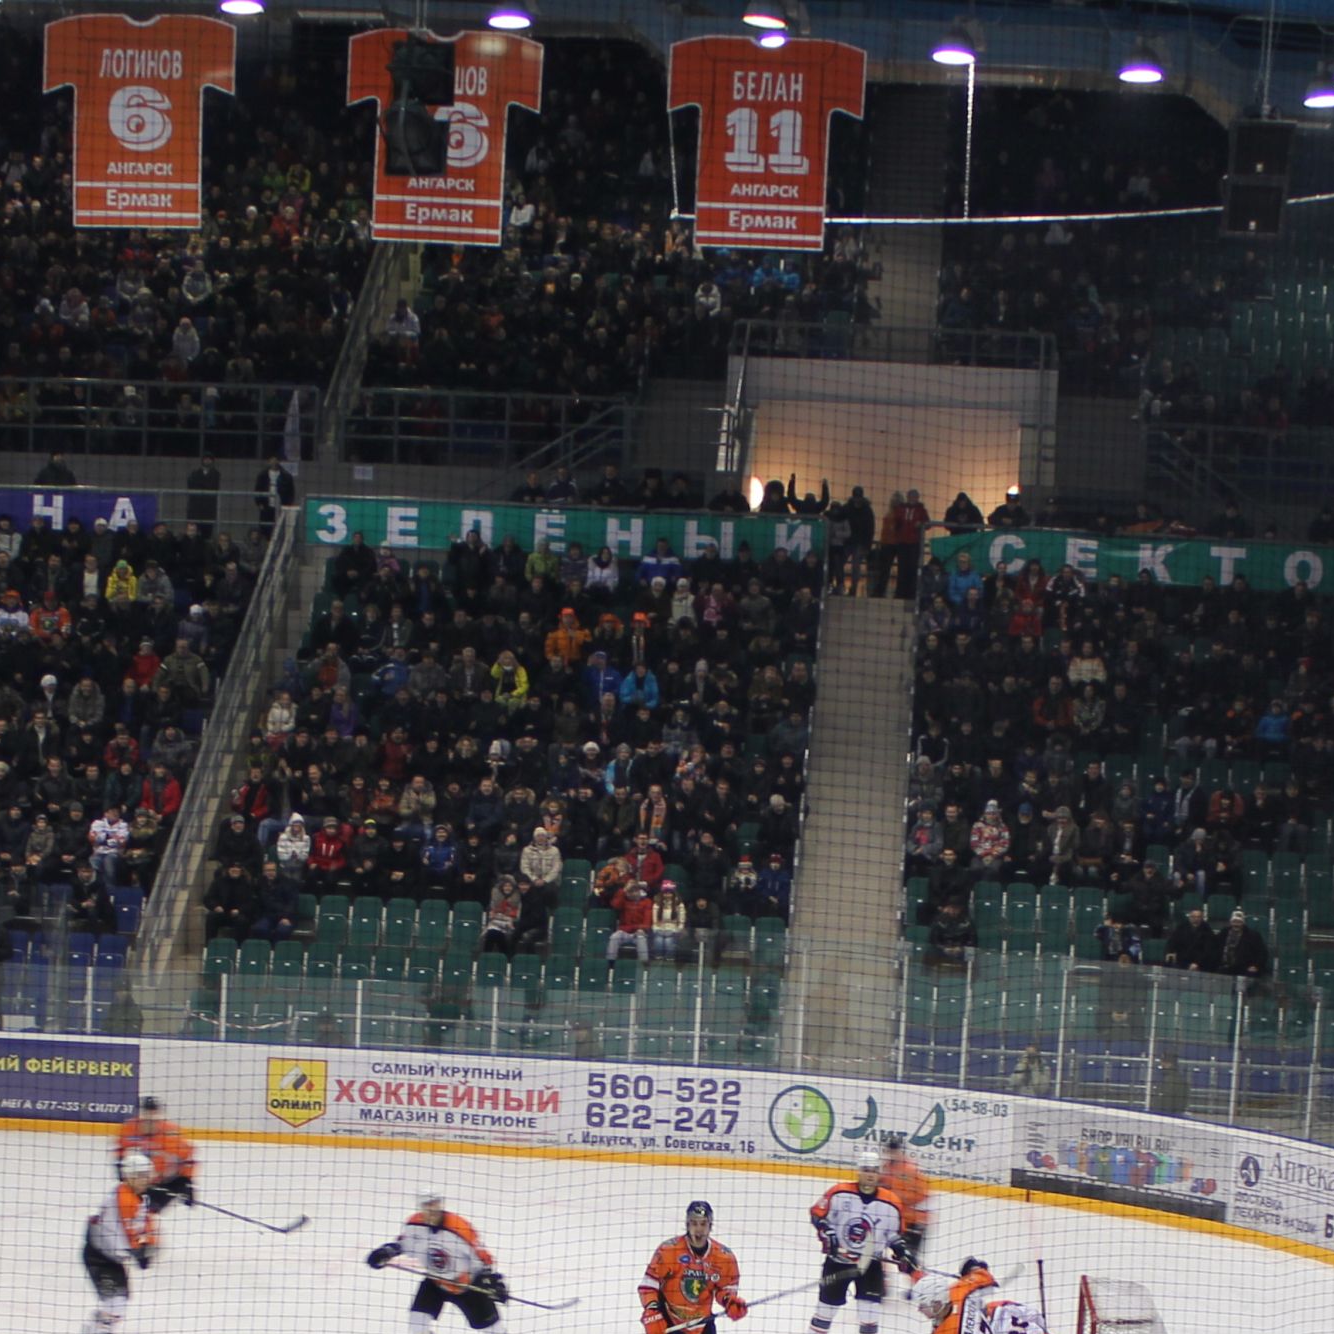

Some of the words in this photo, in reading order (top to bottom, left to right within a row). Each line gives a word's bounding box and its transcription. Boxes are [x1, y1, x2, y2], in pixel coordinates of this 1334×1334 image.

[99, 49, 183, 79] ЛОГИНОВ
[733, 71, 803, 102] БЕЛАН
[108, 85, 172, 152] 6
[724, 107, 809, 174] 11
[106, 162, 173, 176] АНГАРСК
[407, 177, 475, 192] АНГАРСК
[730, 183, 799, 198] АНГАРСК
[106, 189, 172, 209] Ермак
[405, 203, 473, 223] Ермак
[728, 210, 798, 231] Ермак
[316, 503, 812, 562] ЗЕЛЁНЫЙ
[25, 1056, 134, 1078] ФЕЙЕРВЕРК
[371, 1061, 435, 1078] САМЫЙ
[440, 1065, 523, 1082] КРУПНЫЙ
[333, 1078, 560, 1114] ХОККЕЙНЫЙ
[586, 1072, 742, 1106] 560-522
[0, 1098, 33, 1110] МЕГА
[87, 1102, 134, 1114] СИЛУЭТ
[269, 1098, 323, 1111] ОЛИМП
[359, 1108, 438, 1124] МАГАЗИН
[444, 1112, 455, 1124] В
[460, 1114, 538, 1129] РЕГИОНЕ
[585, 1102, 740, 1135] 622-247
[581, 1131, 638, 1148] Иркутск,
[640, 1136, 660, 1149] ул.
[664, 1135, 736, 1154] Советская,
[739, 1140, 756, 1154] 16
